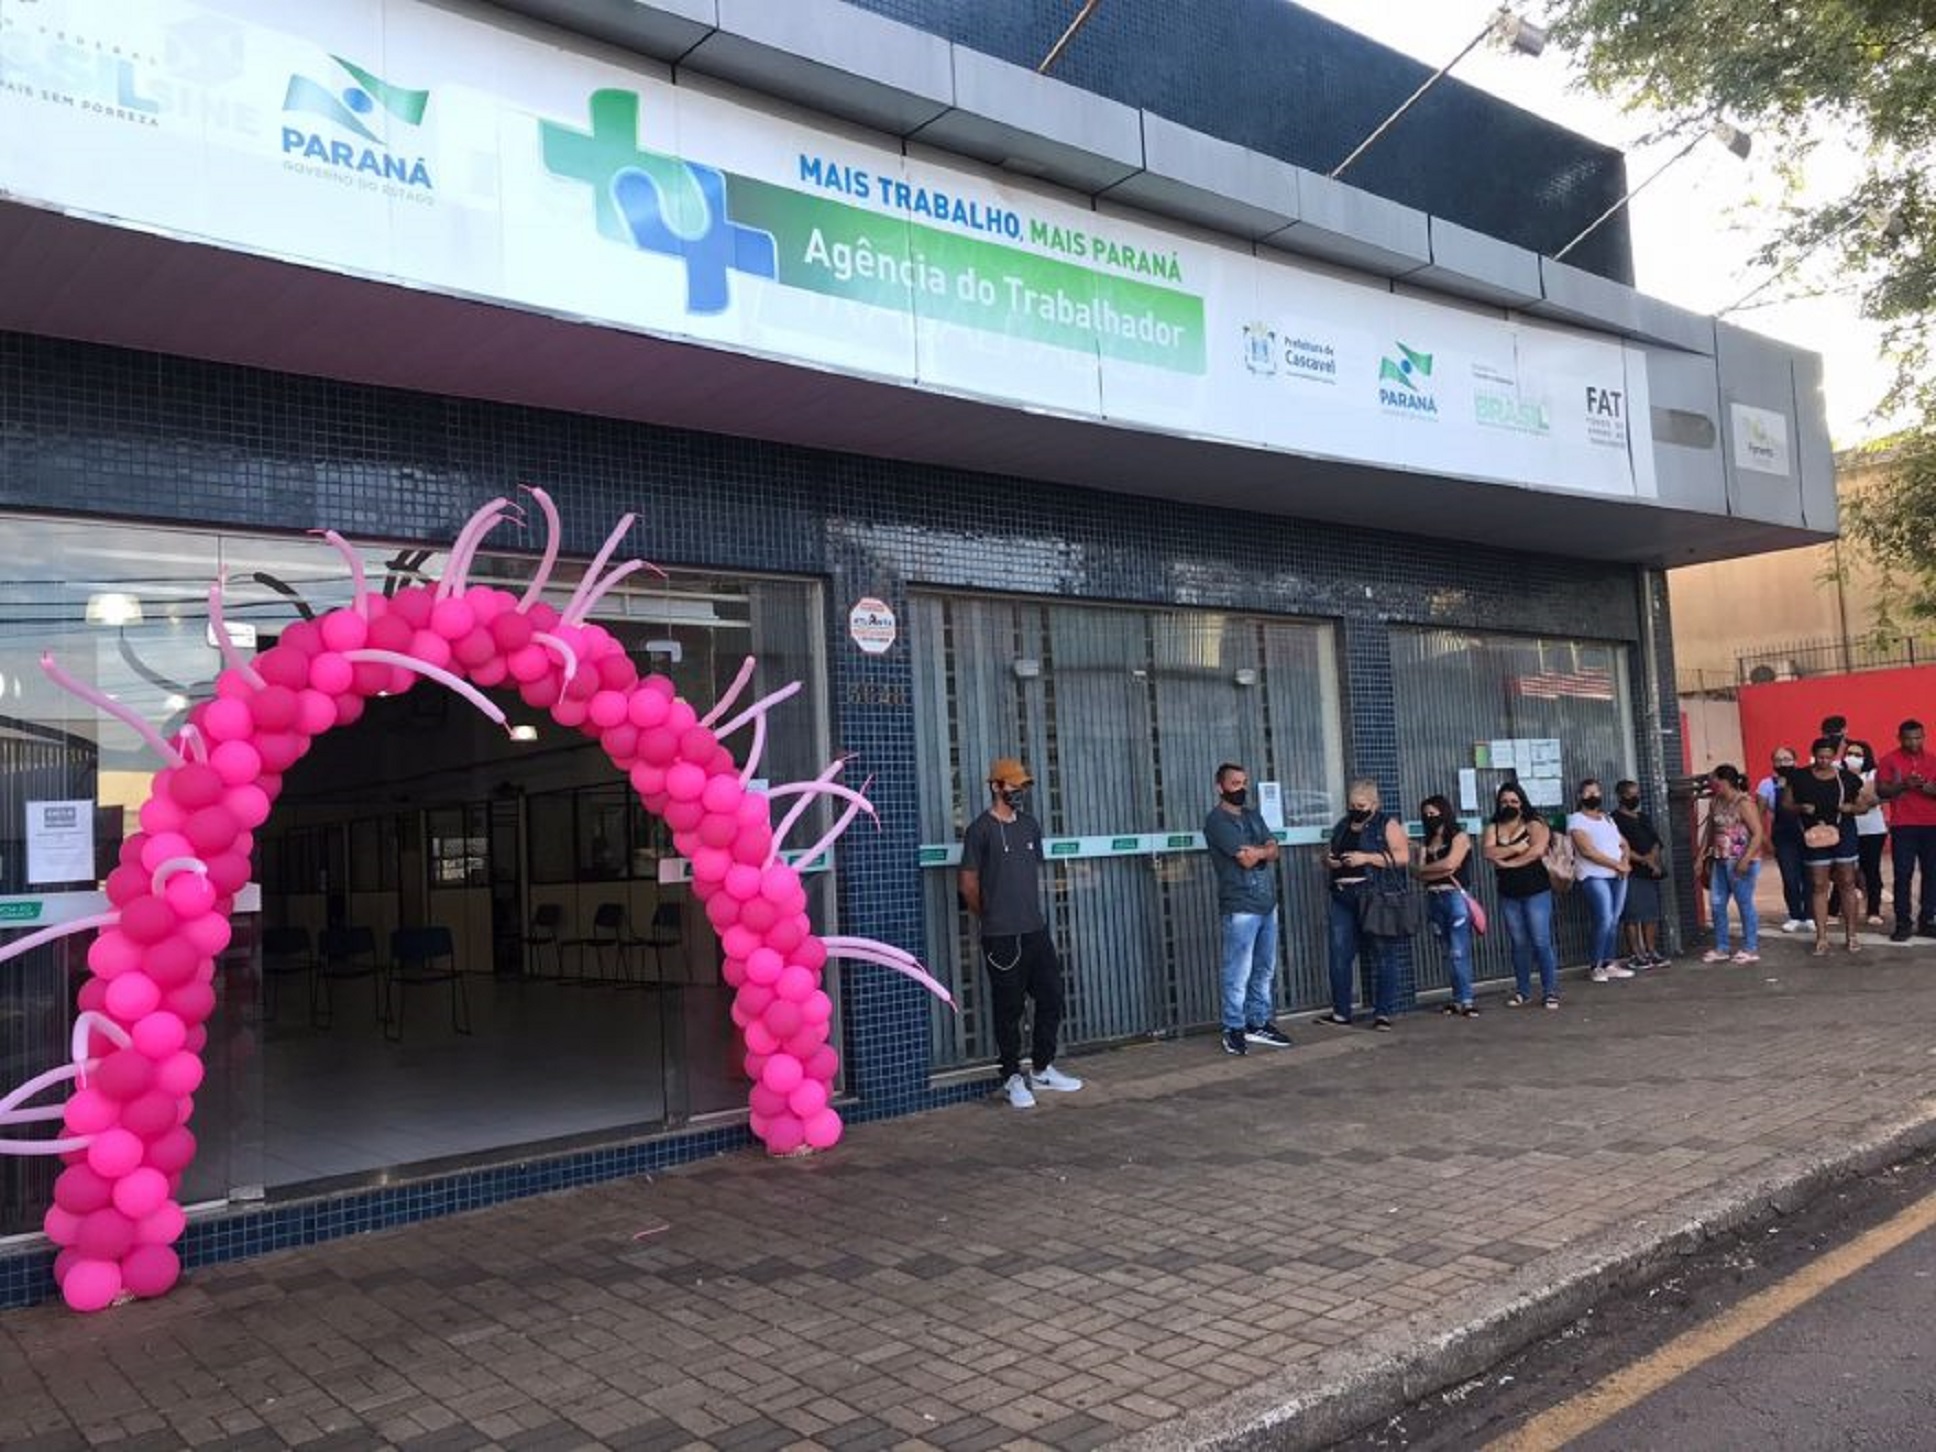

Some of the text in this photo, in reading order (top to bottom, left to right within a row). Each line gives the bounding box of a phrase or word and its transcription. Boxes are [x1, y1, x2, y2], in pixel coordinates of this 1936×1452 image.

[282, 126, 433, 189] PARANÁ
[799, 154, 1182, 283] MAIS TRABALHO, MAIS PARANÁ
[803, 229, 1186, 348] Agência do Trabalhador
[1285, 349, 1336, 375] Cascavel
[1379, 388, 1438, 414] PARANÁ
[1586, 386, 1622, 418] FAT
